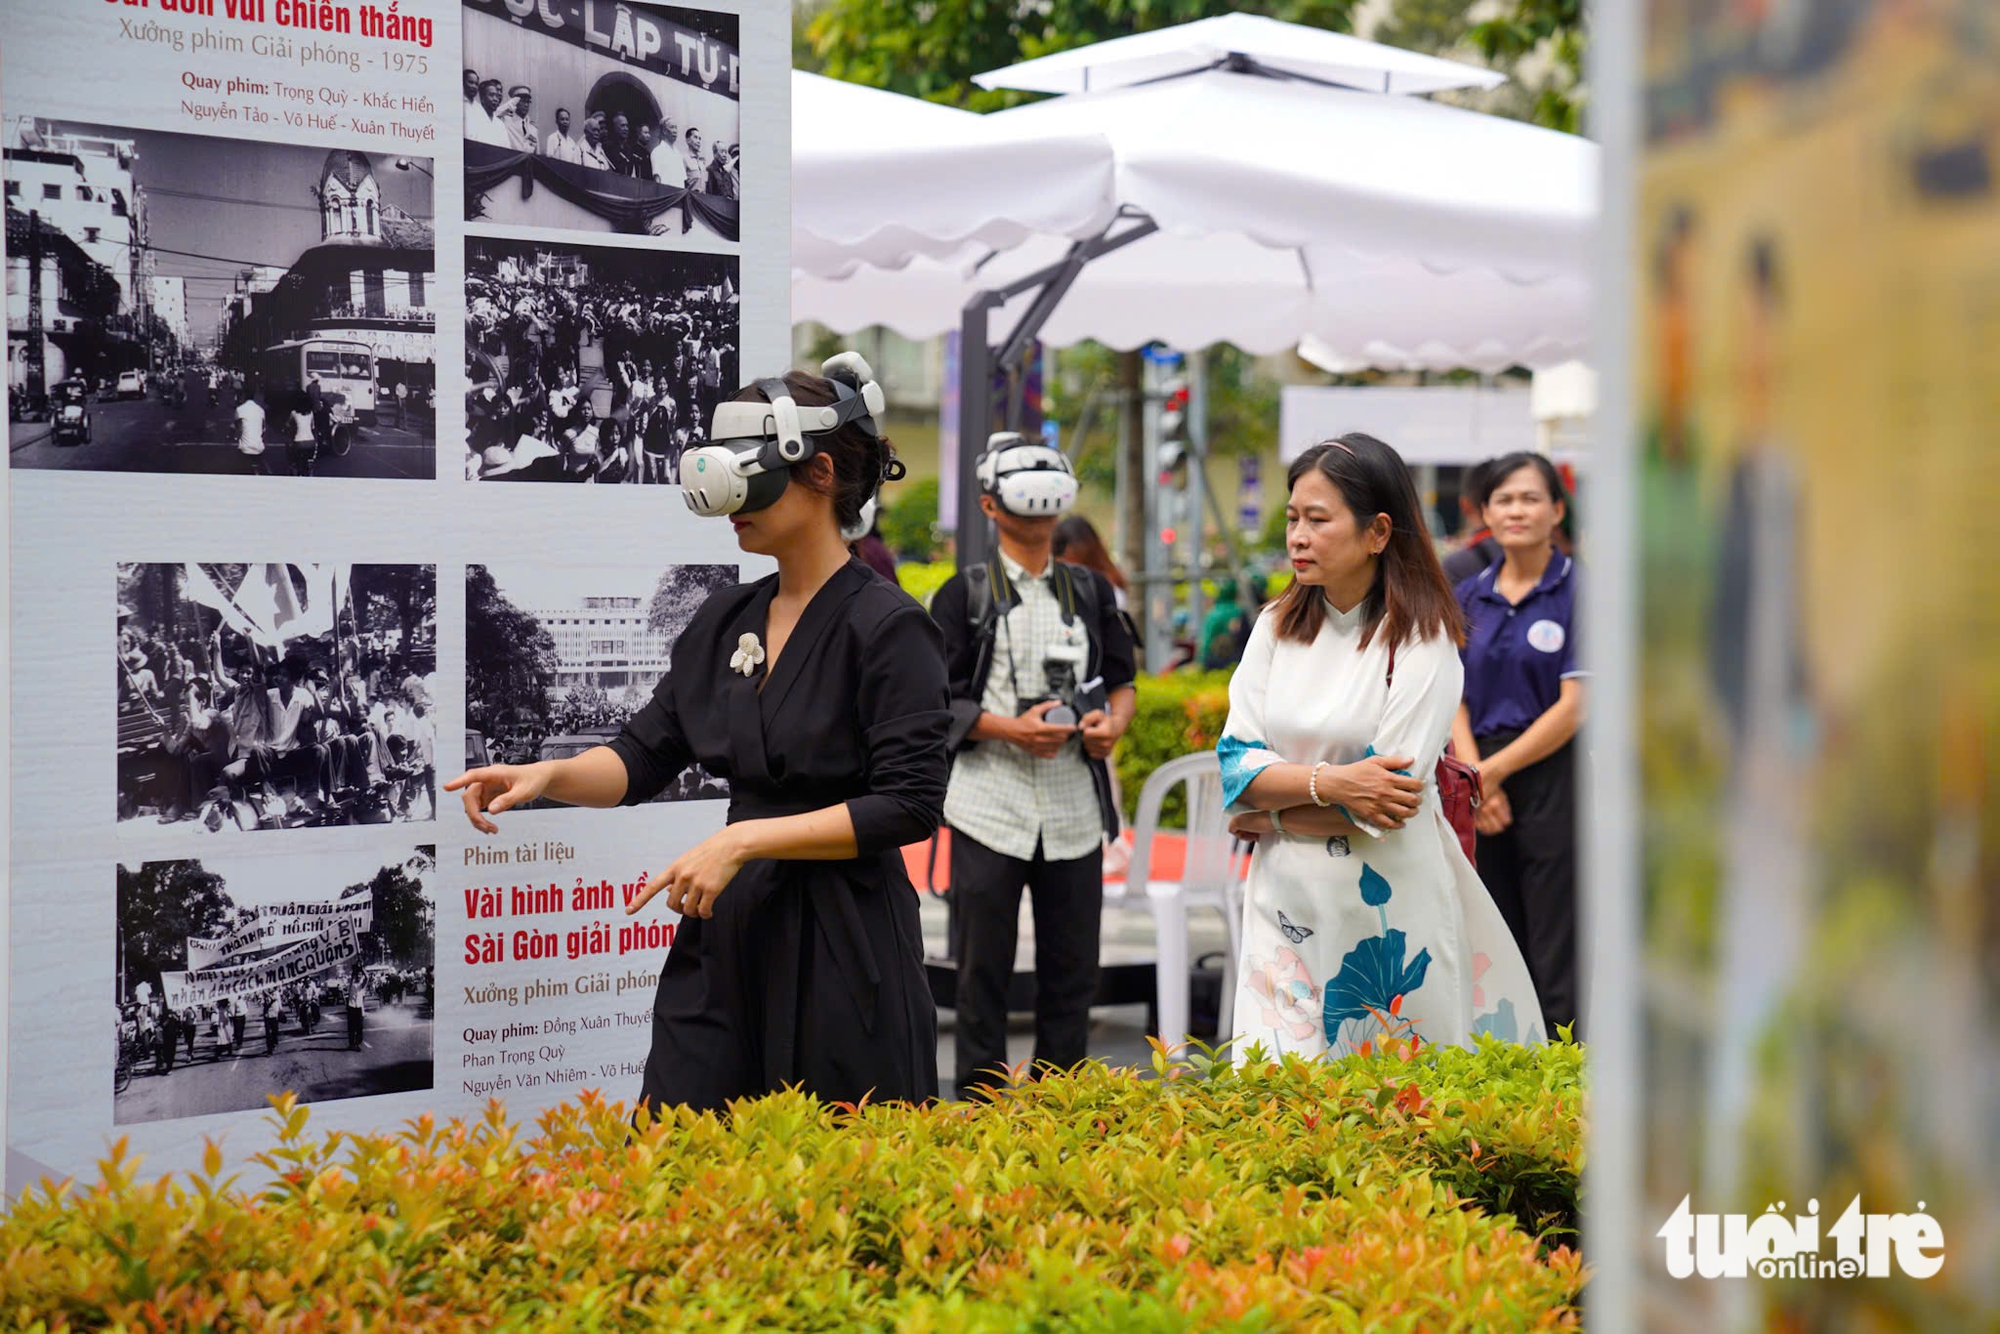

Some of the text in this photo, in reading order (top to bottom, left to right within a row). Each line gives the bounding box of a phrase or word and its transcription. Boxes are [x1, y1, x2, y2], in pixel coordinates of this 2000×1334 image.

[223, 0, 265, 23] vui
[275, 0, 350, 34] chiến
[360, 1, 433, 48] thắng
[119, 17, 184, 52] Xưởng
[192, 27, 243, 54] phim
[252, 35, 292, 59] Giải
[300, 41, 361, 73] phóng
[382, 51, 428, 74] 1975
[181, 71, 222, 94] Quay
[227, 76, 269, 96] phim:
[273, 82, 314, 105] Trọng
[318, 87, 349, 108] Quỳ
[363, 92, 398, 110] Khắc
[402, 95, 435, 114] Hiển
[181, 100, 238, 122] Nguyễn
[242, 106, 269, 124] Tảo
[283, 110, 303, 127] Võ
[308, 113, 338, 130] Huế
[351, 117, 386, 136] Xuân
[390, 121, 436, 143] Thuyết
[464, 841, 575, 866] Phim tài liệu
[464, 886, 503, 919] Vài
[511, 883, 563, 916] hình
[572, 877, 614, 911] ảnh
[464, 919, 680, 965] Sài Gòn giải phón
[464, 970, 661, 1007] Xưởng phim Giải phón
[463, 1028, 498, 1044] Quay
[502, 1022, 539, 1042] phim:
[543, 1016, 577, 1036] Đồng
[580, 1015, 611, 1030] Xuân
[463, 1044, 565, 1068] Phan Trọng Quỳ
[463, 1075, 512, 1097] Nguyễn
[516, 1073, 541, 1087] Văn
[545, 1069, 587, 1085] Nhiêm
[600, 1064, 617, 1078] Võ
